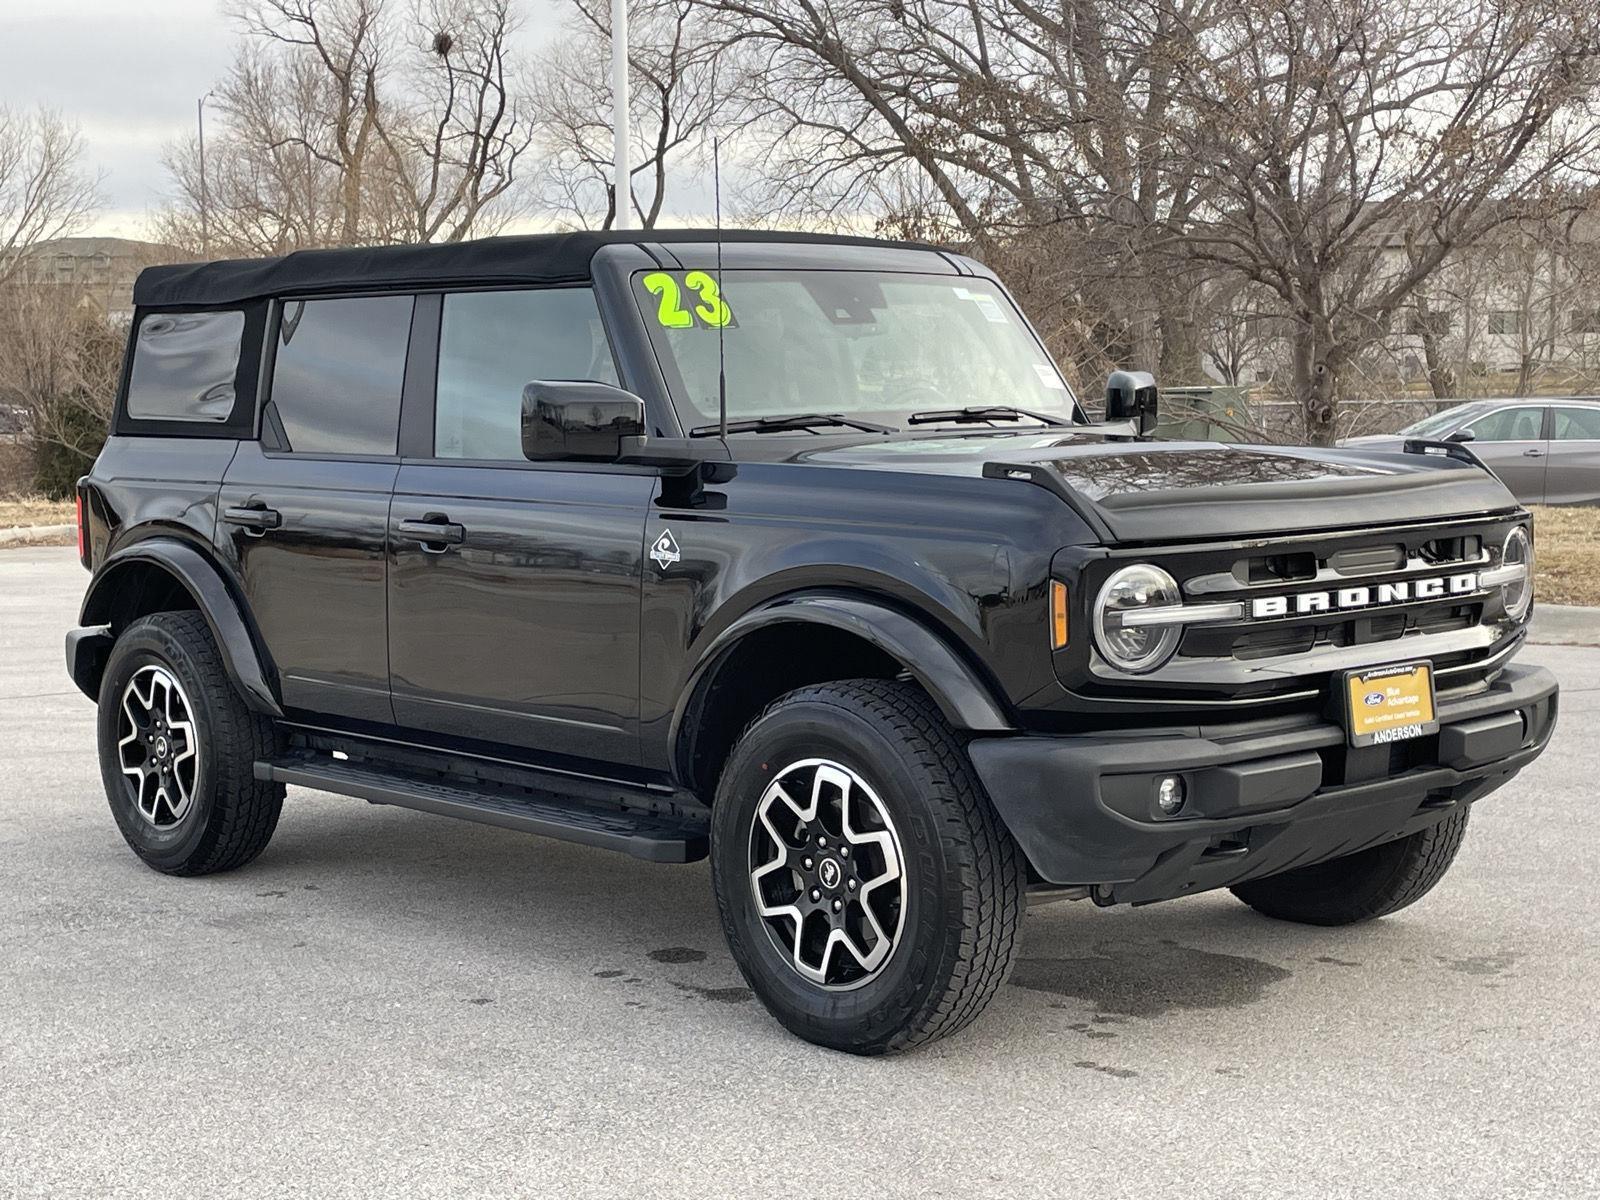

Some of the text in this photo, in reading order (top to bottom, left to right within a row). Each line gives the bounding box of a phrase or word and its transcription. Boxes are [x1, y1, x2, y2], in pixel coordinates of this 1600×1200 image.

[643, 271, 731, 328] 23
[1252, 573, 1477, 617] BRONCO
[1373, 724, 1422, 744] ANDERSON
